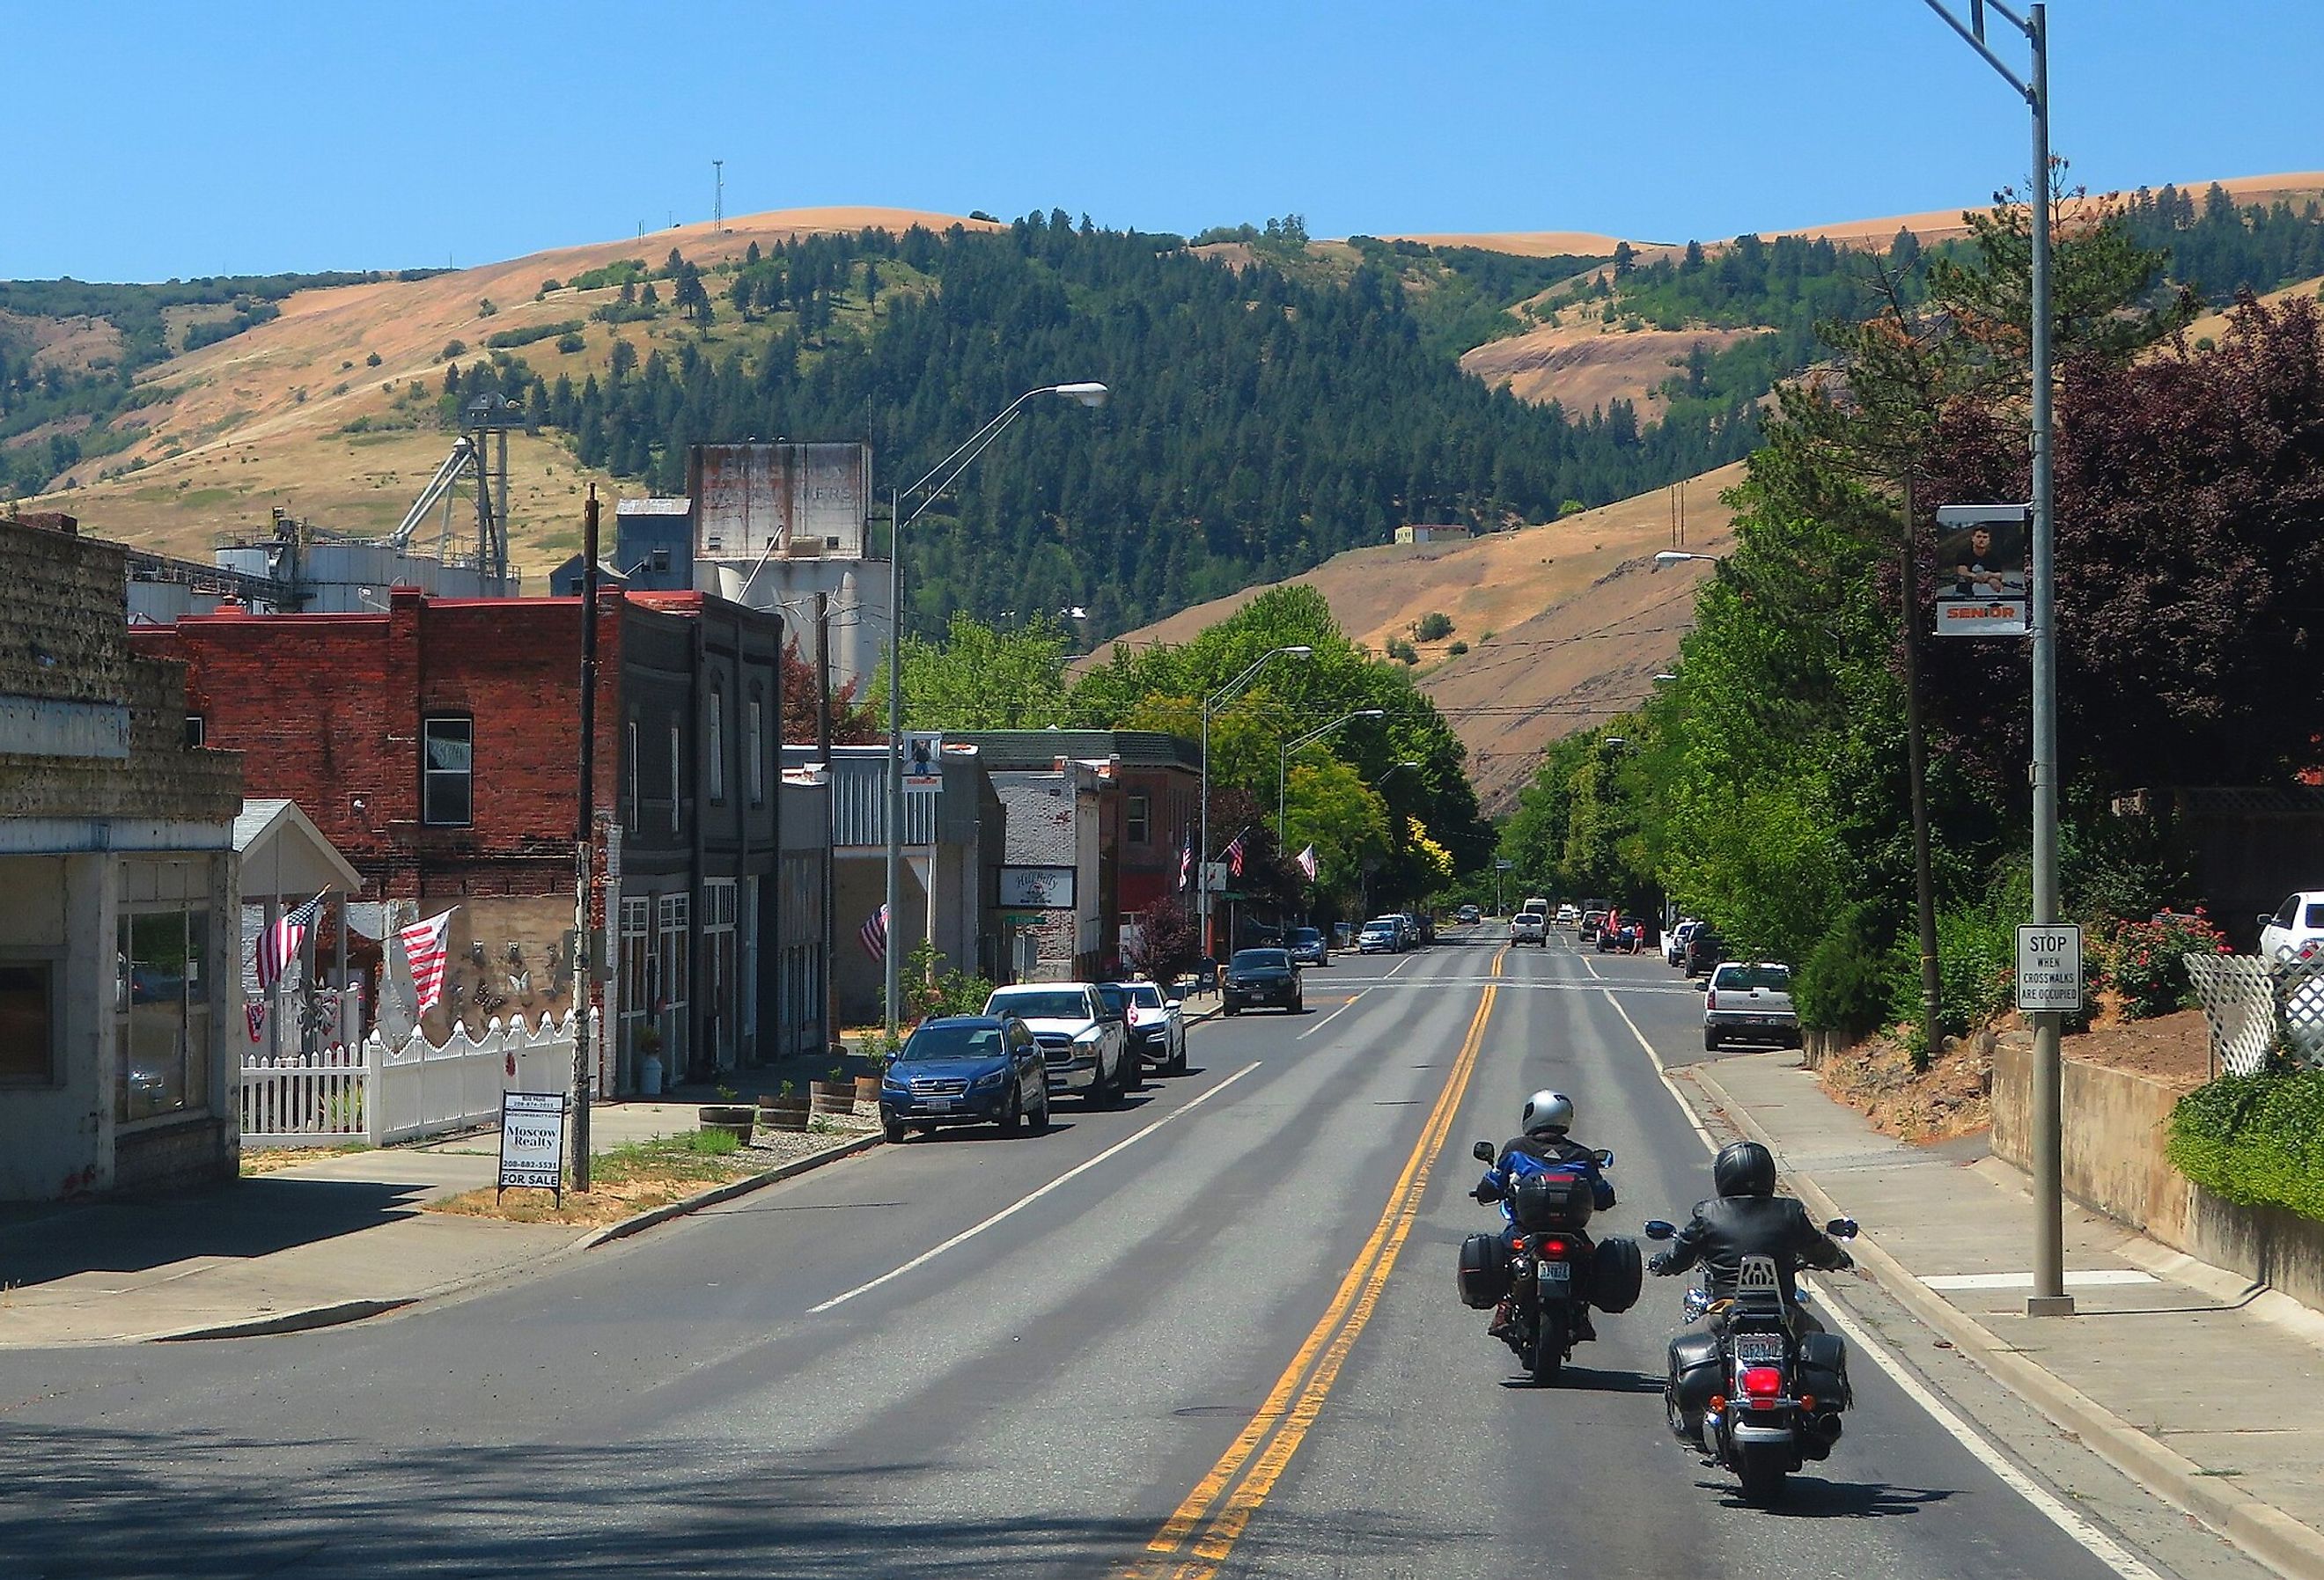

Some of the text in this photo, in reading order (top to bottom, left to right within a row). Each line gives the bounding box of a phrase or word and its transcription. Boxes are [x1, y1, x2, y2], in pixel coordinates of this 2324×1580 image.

[1946, 607, 2015, 619] SENIOR
[2030, 936, 2067, 952] STOP
[2037, 958, 2060, 967] WHEN
[2023, 973, 2074, 983] CROSSWALKS
[2021, 988, 2077, 999] ARE OCCUPIED
[507, 1126, 557, 1137] Moscow
[515, 1136, 554, 1150] Realty
[504, 1160, 557, 1169] 208-882-5531
[502, 1174, 557, 1186] FOR SALE
